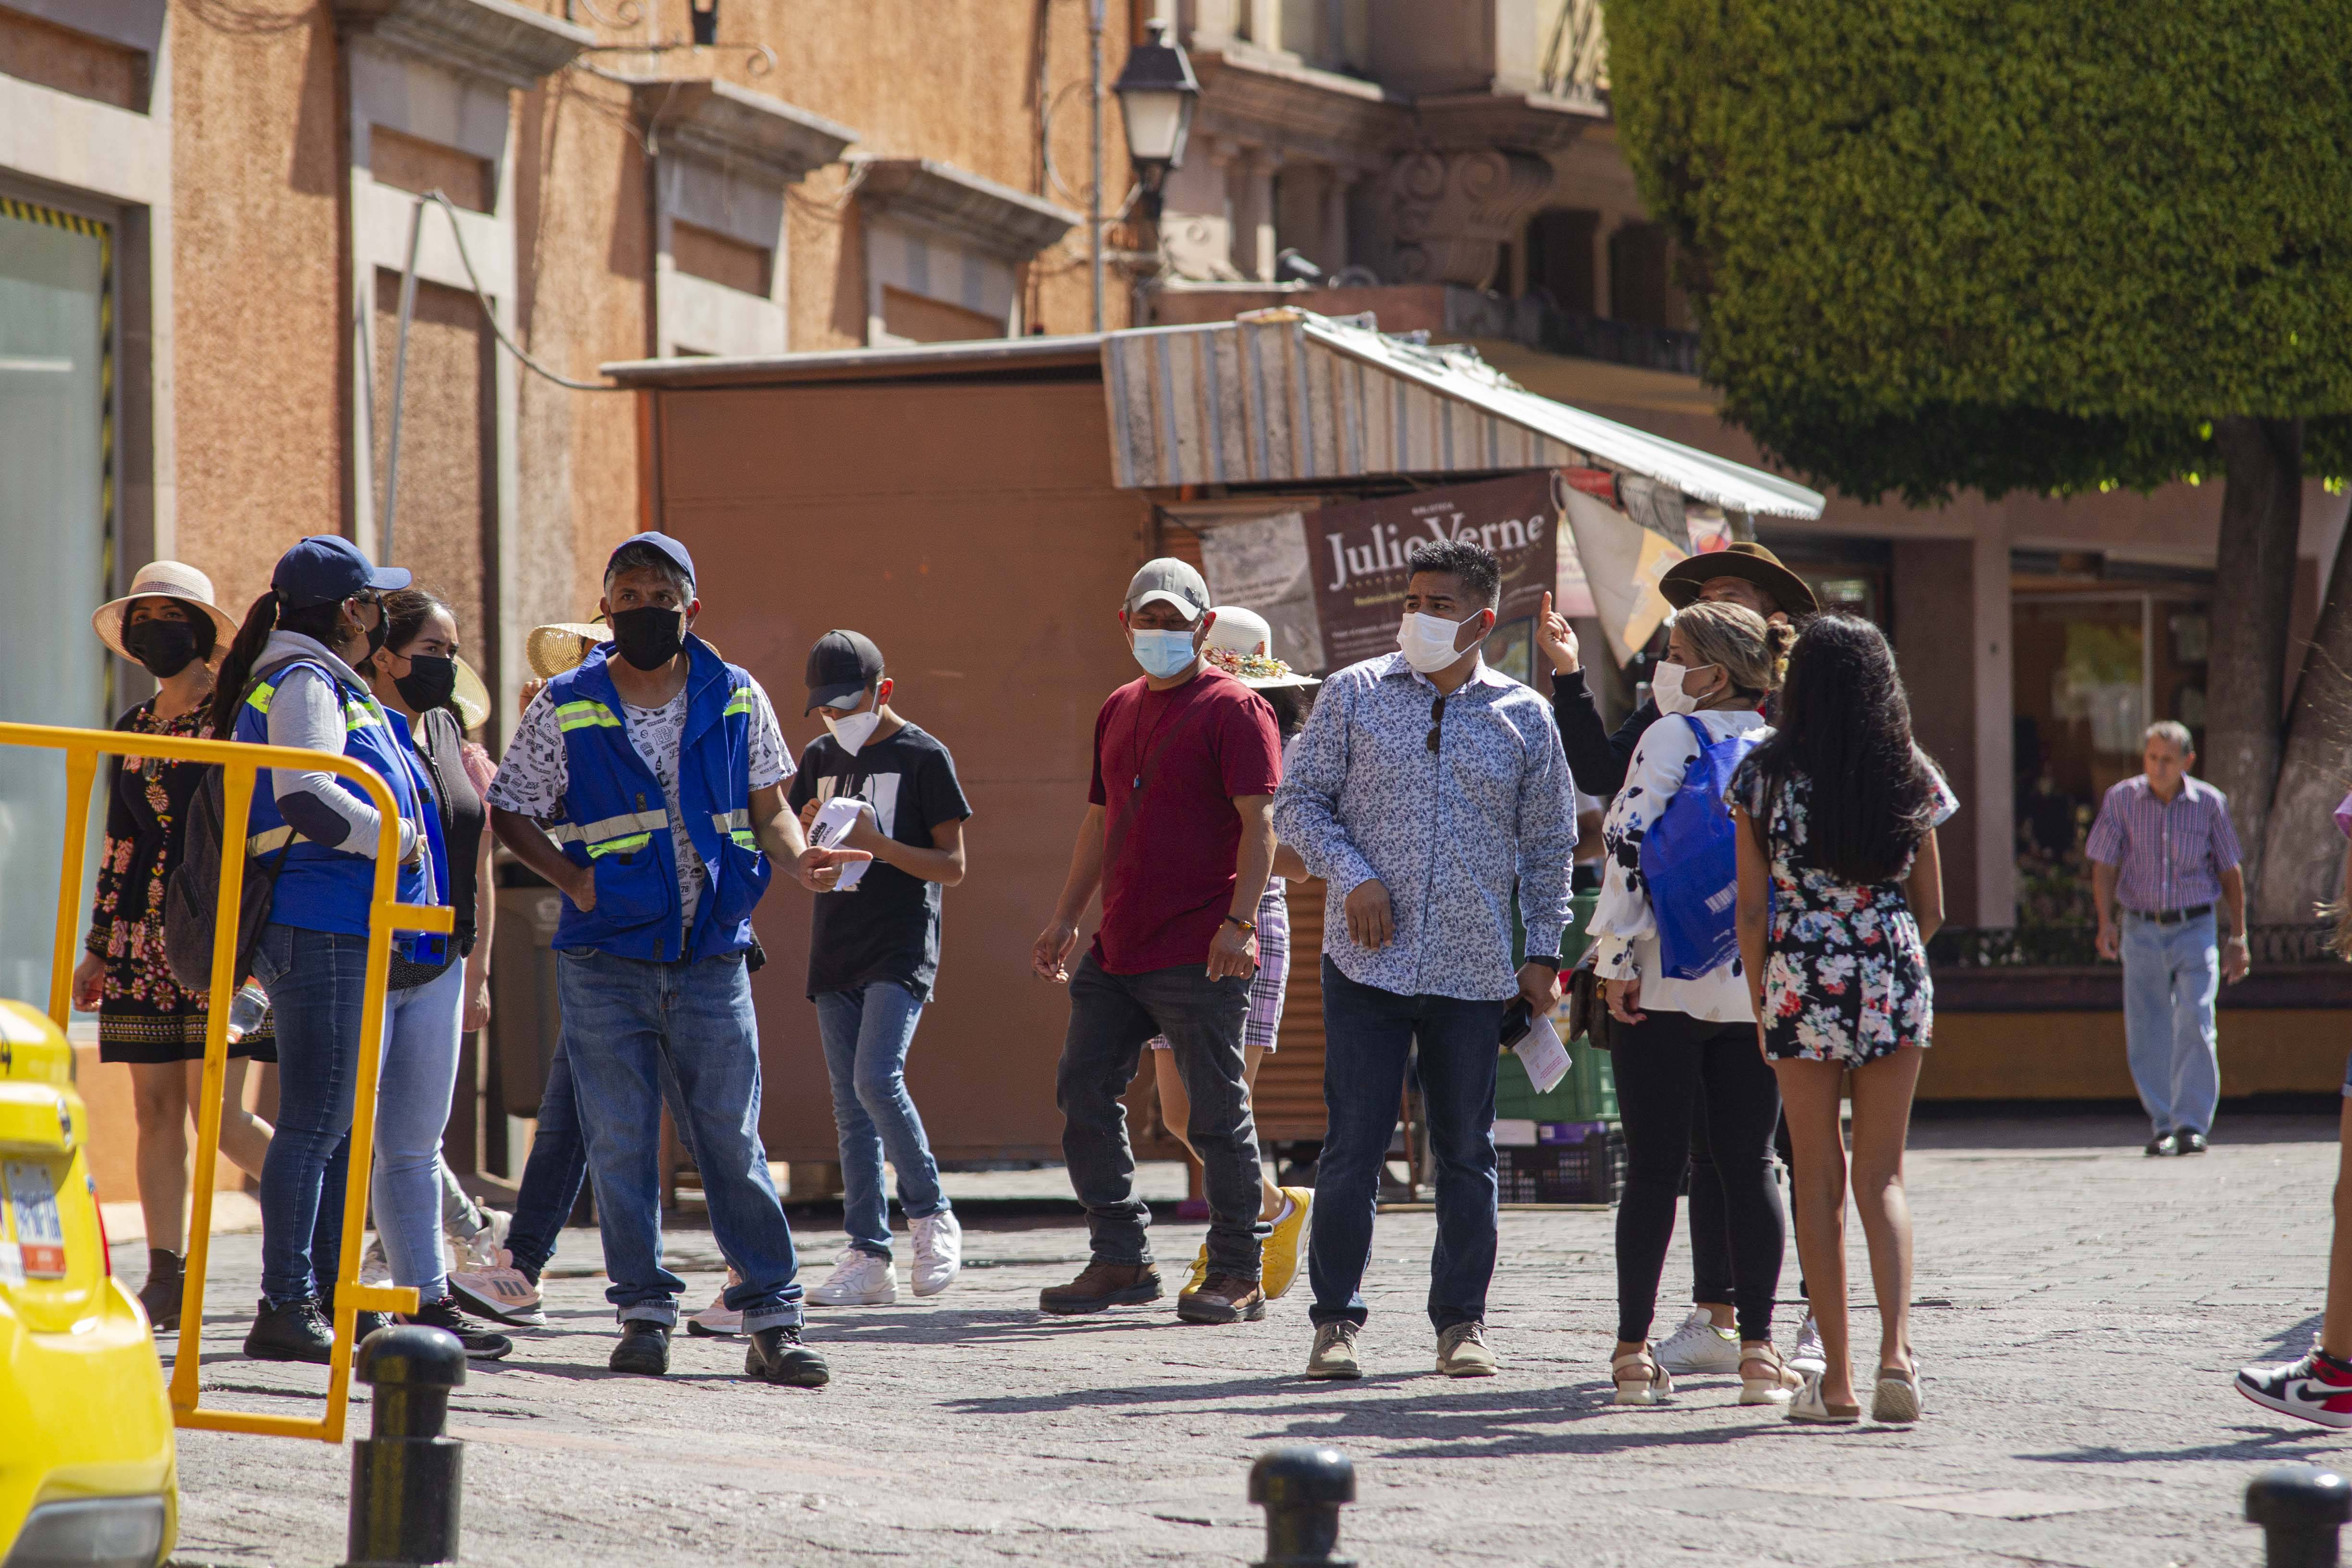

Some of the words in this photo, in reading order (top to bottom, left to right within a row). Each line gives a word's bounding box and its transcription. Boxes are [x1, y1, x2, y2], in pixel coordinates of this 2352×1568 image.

[1325, 523, 1428, 592] Julio
[1422, 512, 1545, 551] Verne
[661, 740, 677, 750] QUEENS
